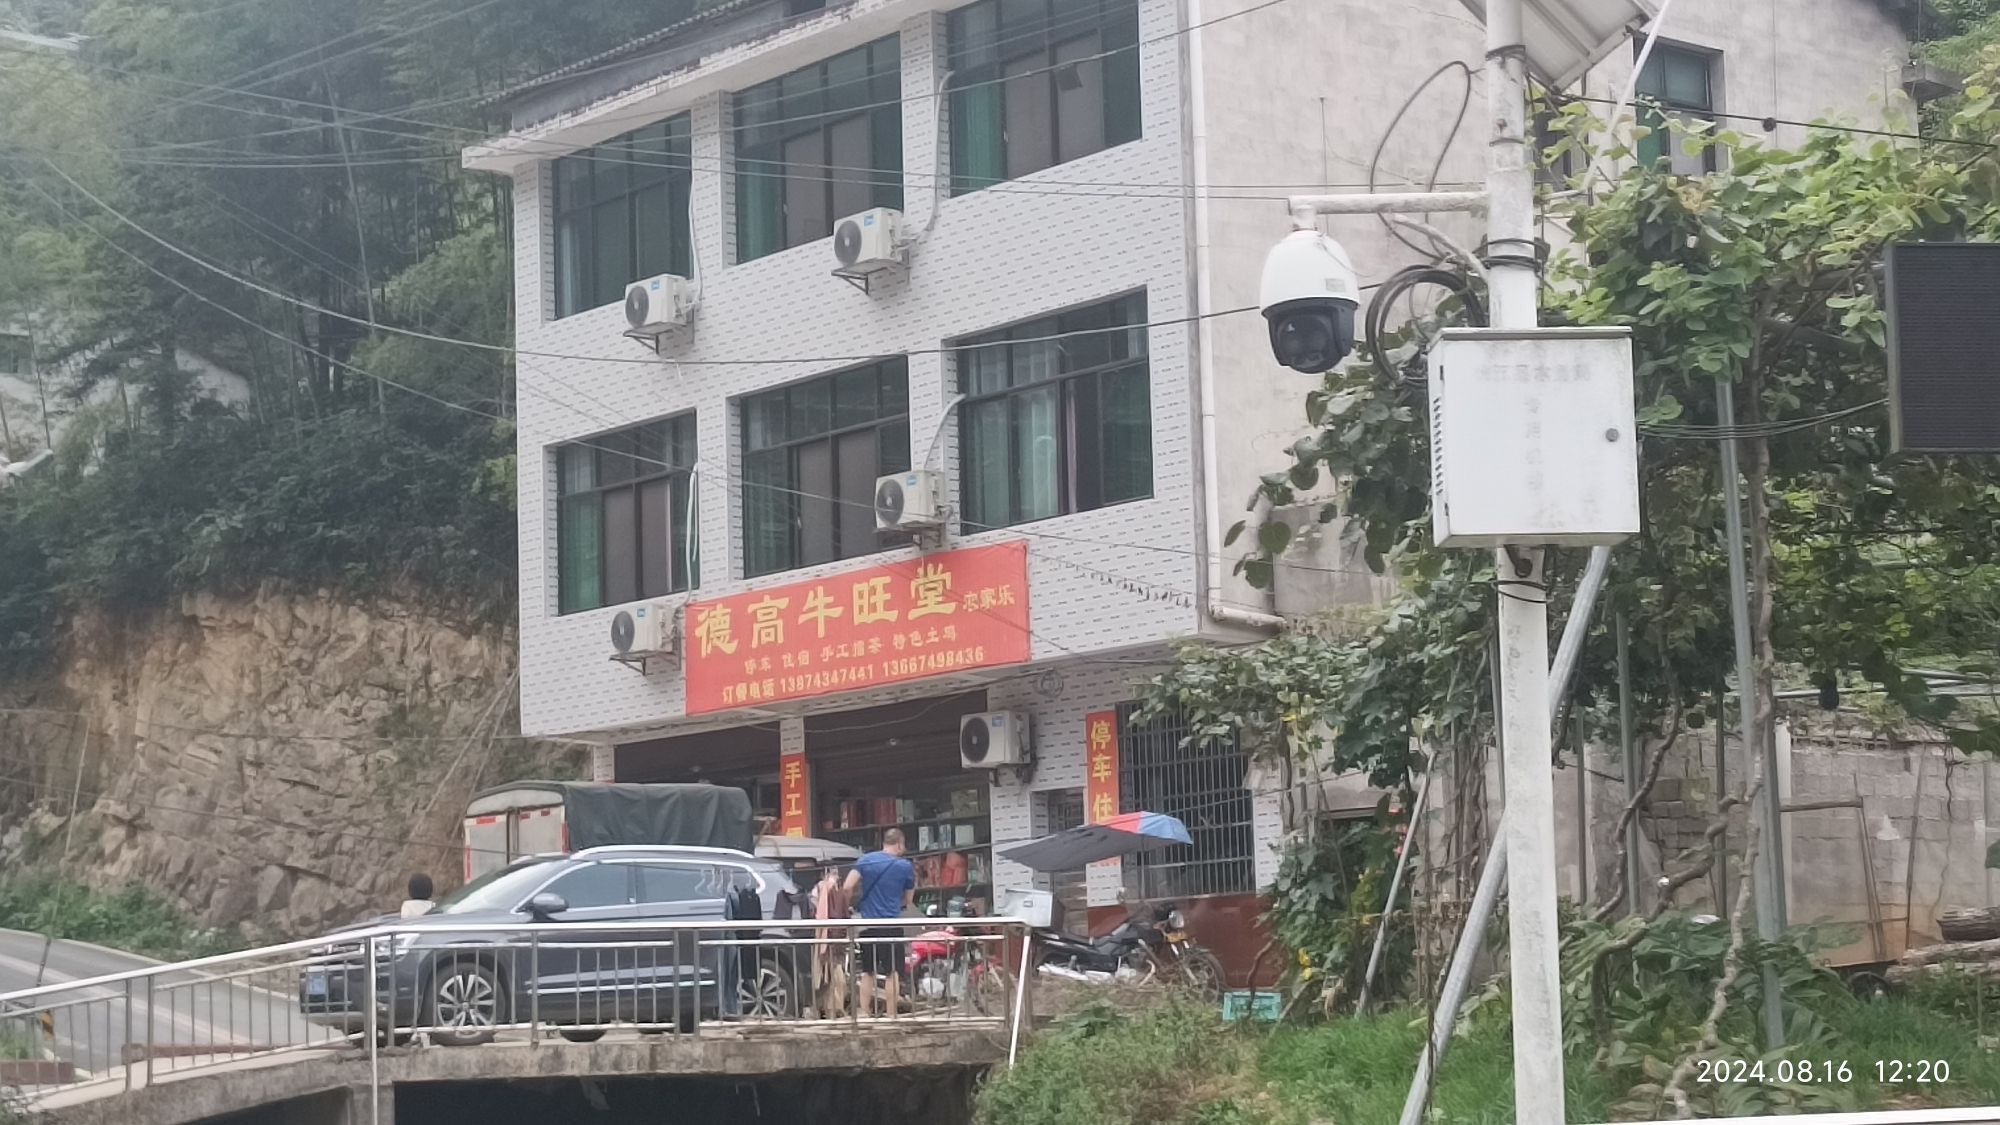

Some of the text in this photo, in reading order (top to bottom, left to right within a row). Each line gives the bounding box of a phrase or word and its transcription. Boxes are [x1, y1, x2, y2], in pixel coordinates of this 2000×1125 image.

[695, 563, 957, 658] 德高牛旺堂
